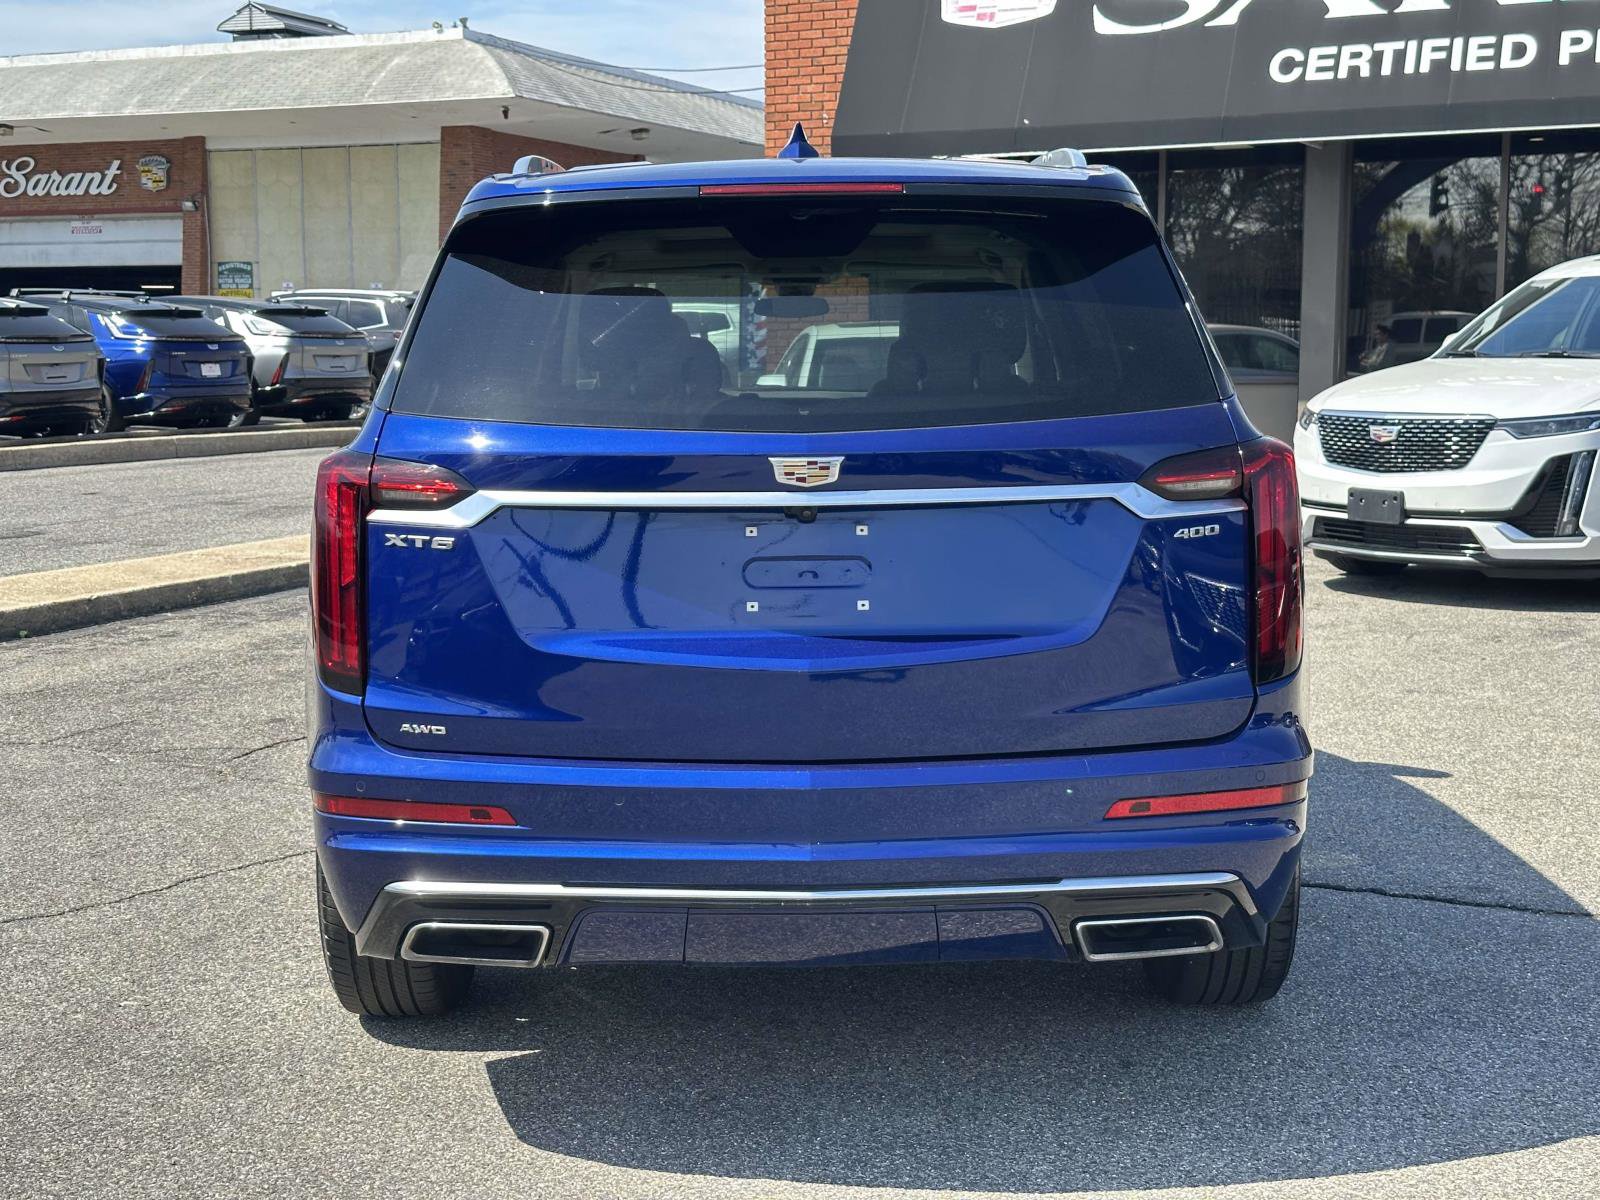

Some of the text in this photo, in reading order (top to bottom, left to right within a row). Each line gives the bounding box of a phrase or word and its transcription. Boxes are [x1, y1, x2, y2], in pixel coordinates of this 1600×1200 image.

[1268, 29, 1600, 83] CERTIFIED P
[0, 156, 121, 198] Sarant
[1173, 524, 1220, 539] 400
[384, 533, 456, 550] XT6
[399, 723, 447, 735] AWD
